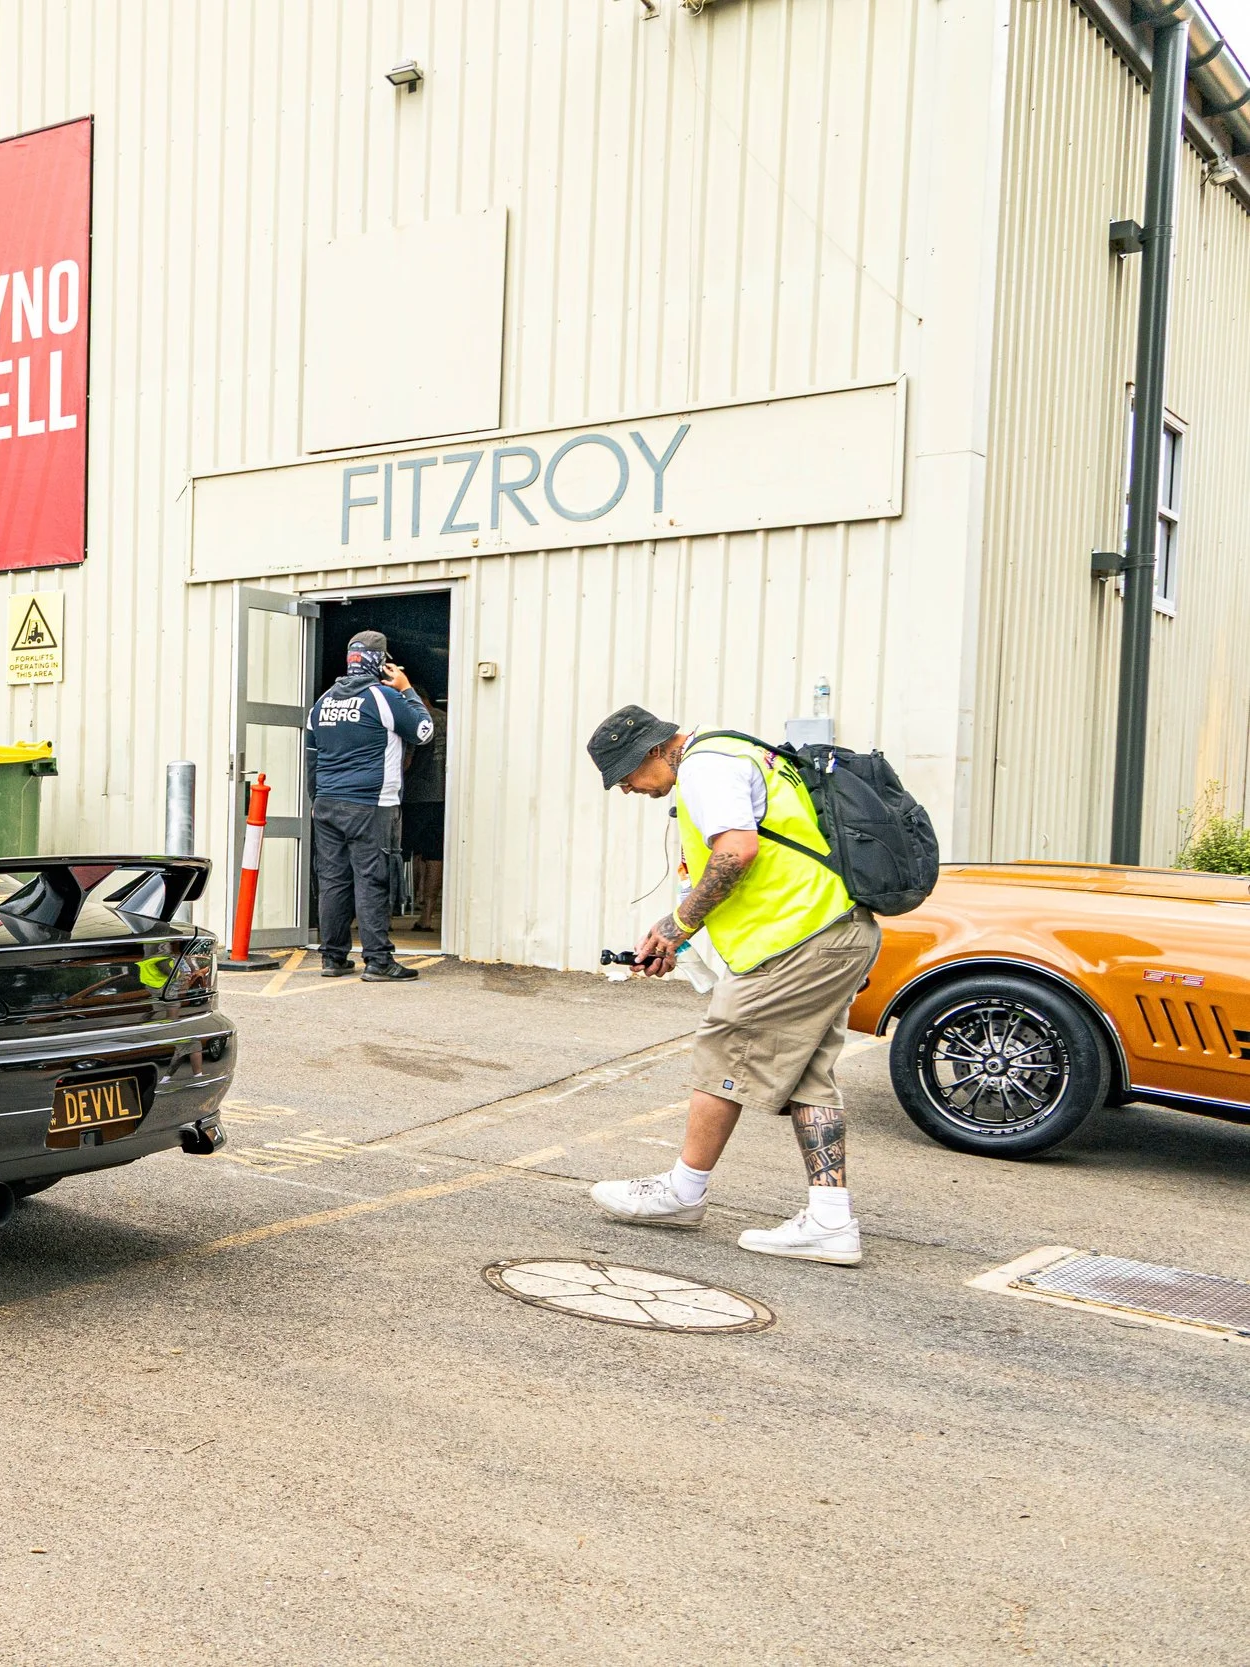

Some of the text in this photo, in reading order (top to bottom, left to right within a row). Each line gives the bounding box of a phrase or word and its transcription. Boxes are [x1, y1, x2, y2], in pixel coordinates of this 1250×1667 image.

[341, 424, 692, 545] FITZROY
[15, 653, 55, 662] FORKLIFTS
[9, 661, 59, 671] OPERATING IN
[16, 670, 32, 678] THIS
[319, 708, 360, 722] NSRG
[1143, 969, 1205, 988] GTS
[976, 999, 1025, 1011] WELD
[64, 1085, 130, 1125] DEVVL
